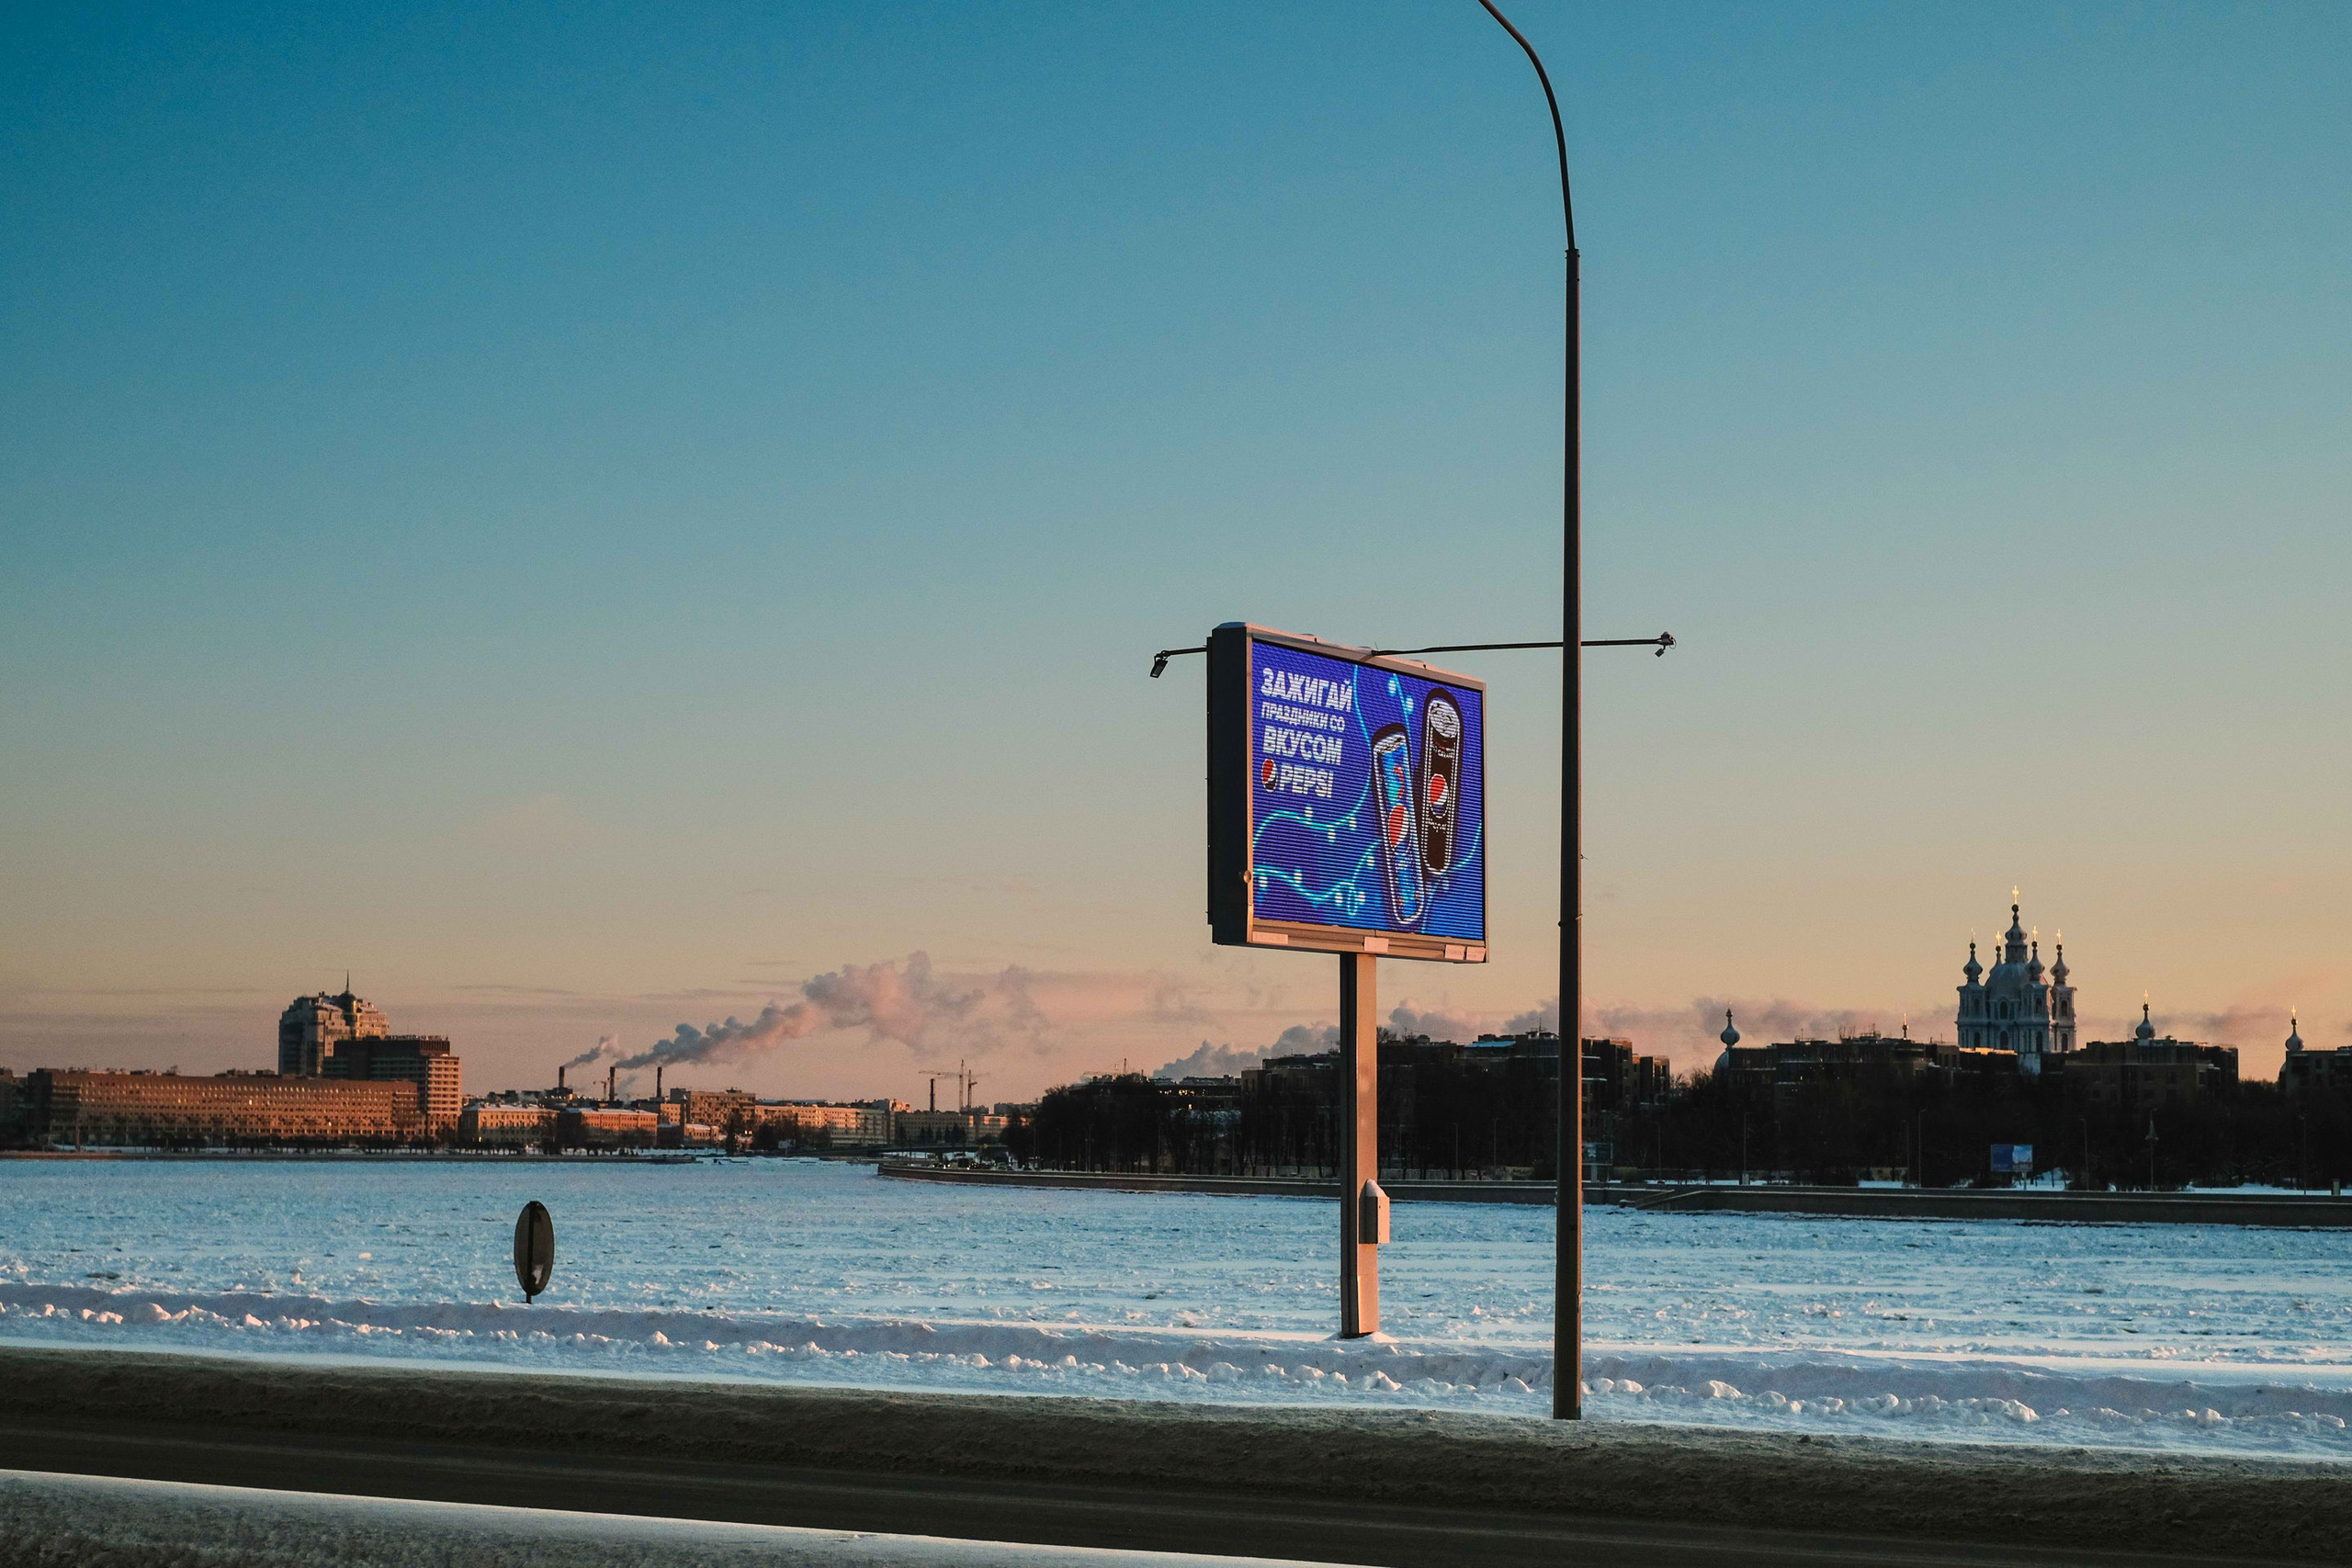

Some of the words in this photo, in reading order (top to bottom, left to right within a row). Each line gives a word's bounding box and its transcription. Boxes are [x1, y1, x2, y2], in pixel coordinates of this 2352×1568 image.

[1261, 667, 1352, 713] ЗАЖИГАЙ
[1261, 701, 1329, 729] ПРАЗДНИКИ
[1329, 714, 1345, 732] СО
[1262, 725, 1342, 765] ВКУСОМ
[1279, 763, 1334, 798] PEPSI
